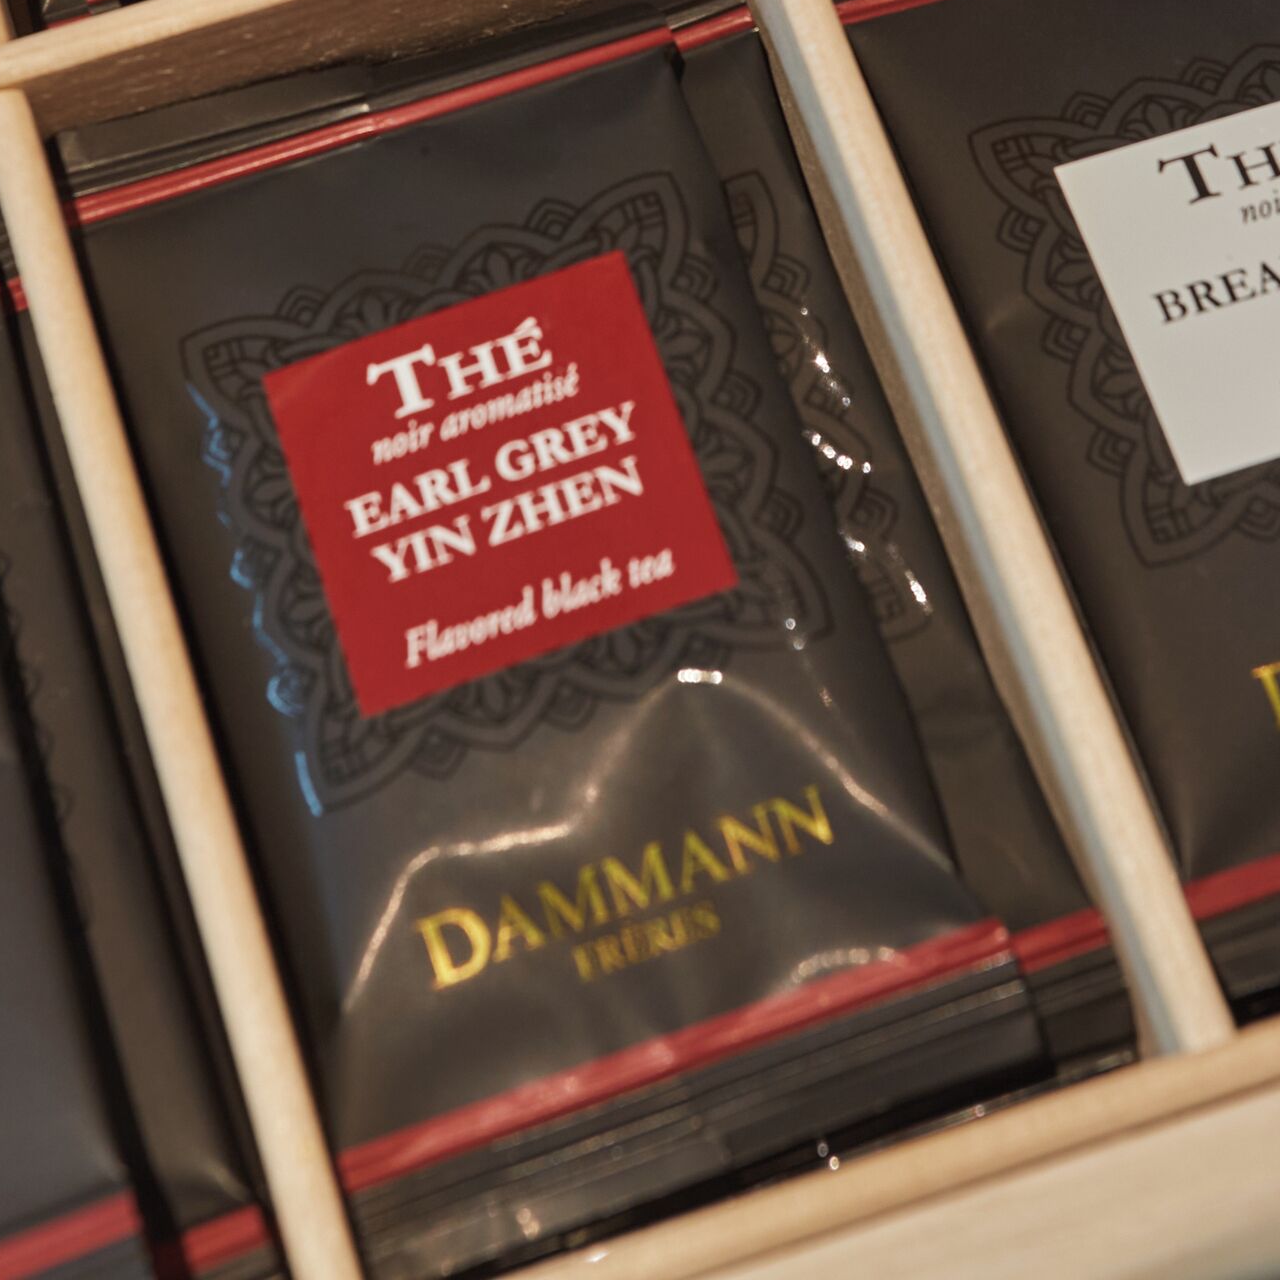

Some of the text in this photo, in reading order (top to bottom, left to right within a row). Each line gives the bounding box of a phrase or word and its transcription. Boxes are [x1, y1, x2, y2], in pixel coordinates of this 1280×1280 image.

[366, 317, 553, 420] THÉ
[370, 363, 580, 465] noir aromatisé
[344, 400, 637, 539] EARL GREY
[370, 456, 644, 583] YIN ZHEN
[405, 549, 675, 669] Flavored black tea
[418, 785, 834, 990] DAMMANN
